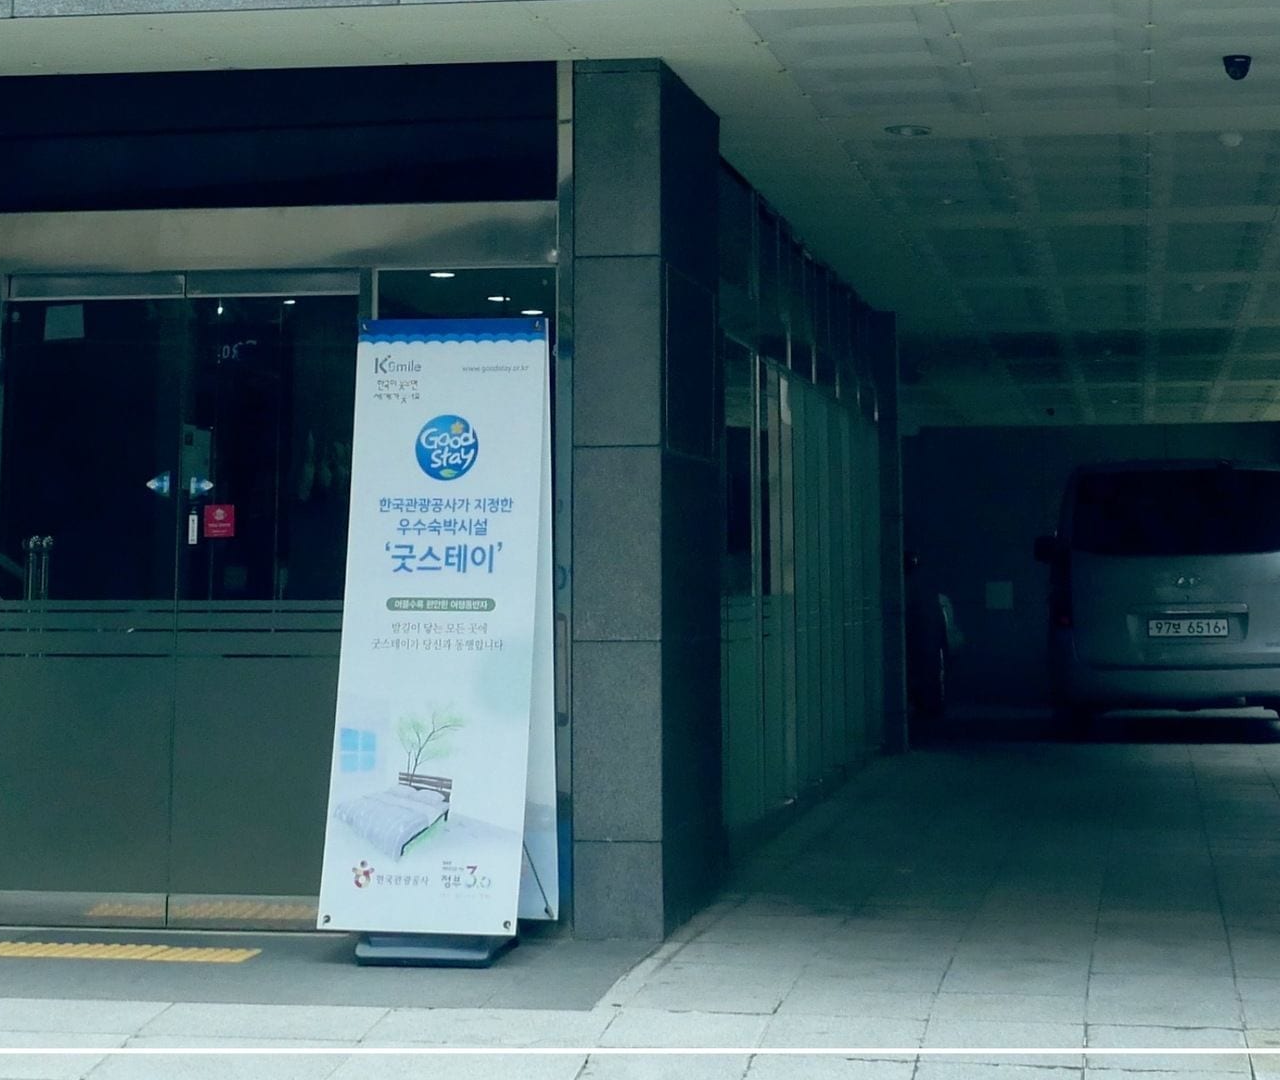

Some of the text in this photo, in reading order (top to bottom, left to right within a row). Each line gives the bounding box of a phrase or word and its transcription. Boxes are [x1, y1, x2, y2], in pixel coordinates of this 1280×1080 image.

[421, 423, 475, 449] Good
[430, 447, 475, 471] stay
[379, 497, 514, 513] 한국관광공사가 지정한
[396, 518, 488, 536] 우수숙박시설
[1187, 621, 1221, 634] 6516
